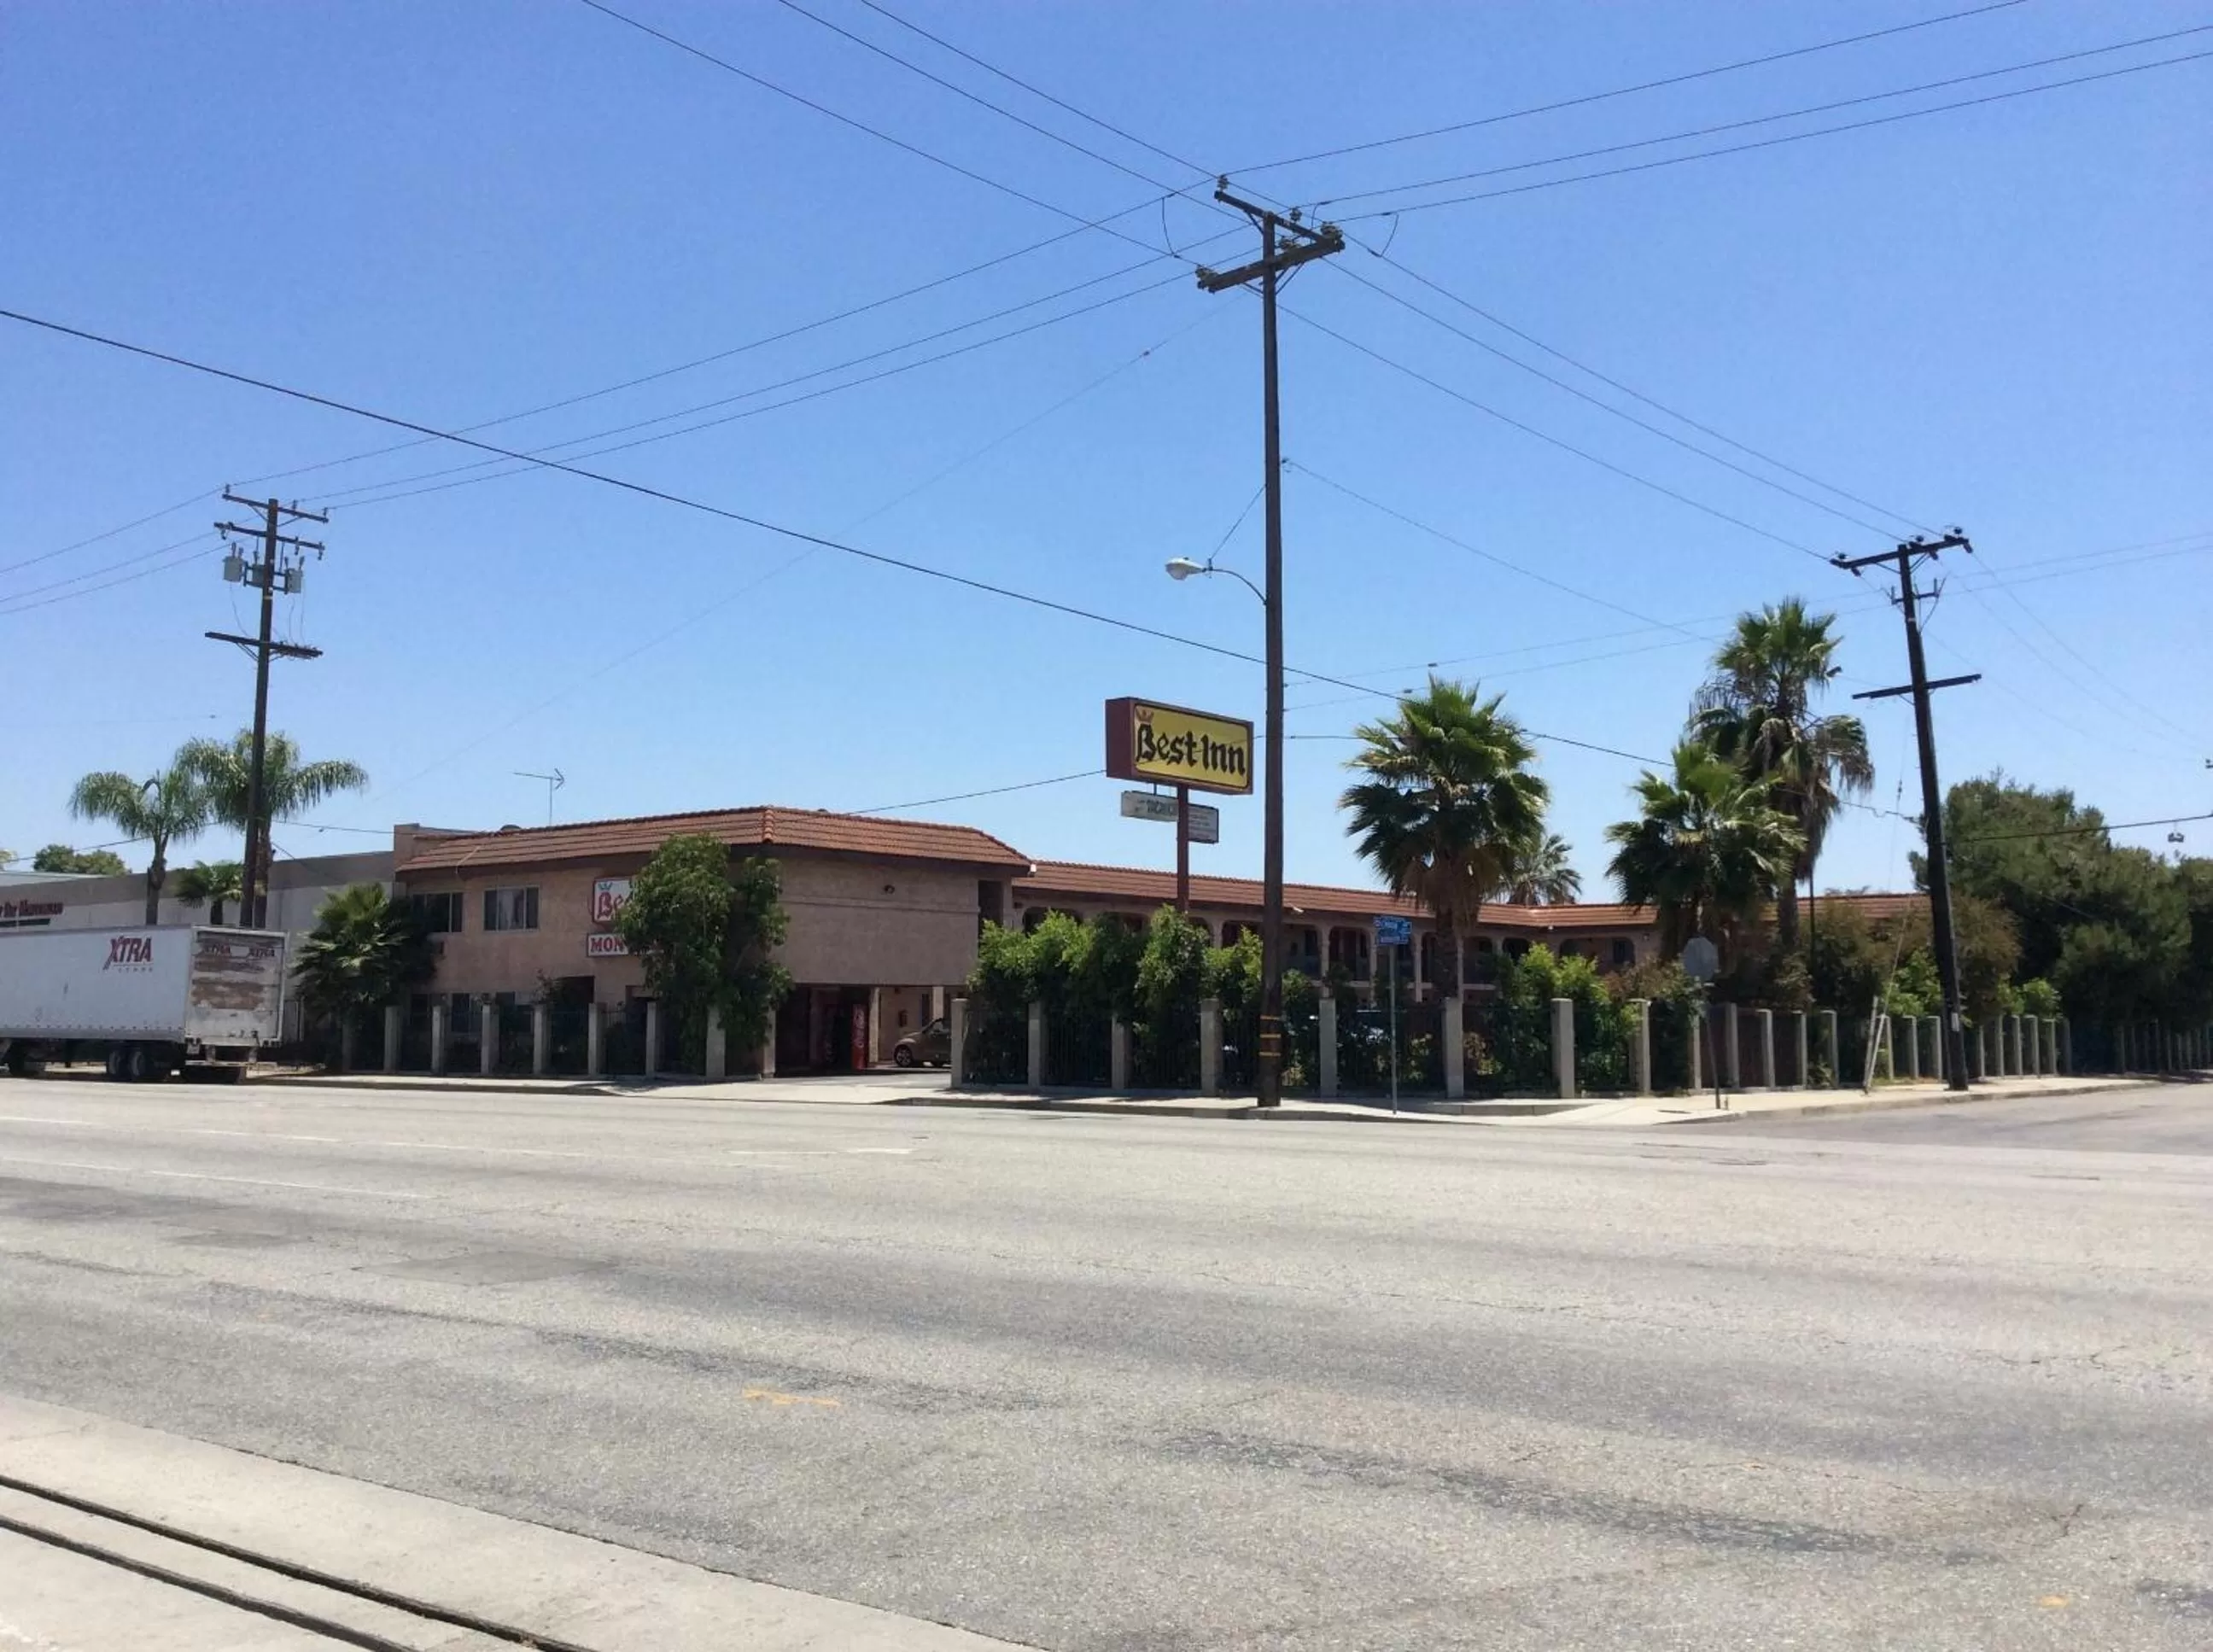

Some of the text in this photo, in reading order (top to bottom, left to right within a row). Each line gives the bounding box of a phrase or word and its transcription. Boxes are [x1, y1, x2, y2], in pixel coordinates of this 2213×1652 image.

[1136, 724, 1246, 776] Best Inn
[102, 936, 152, 970] XTRA
[590, 937, 625, 953] MON
